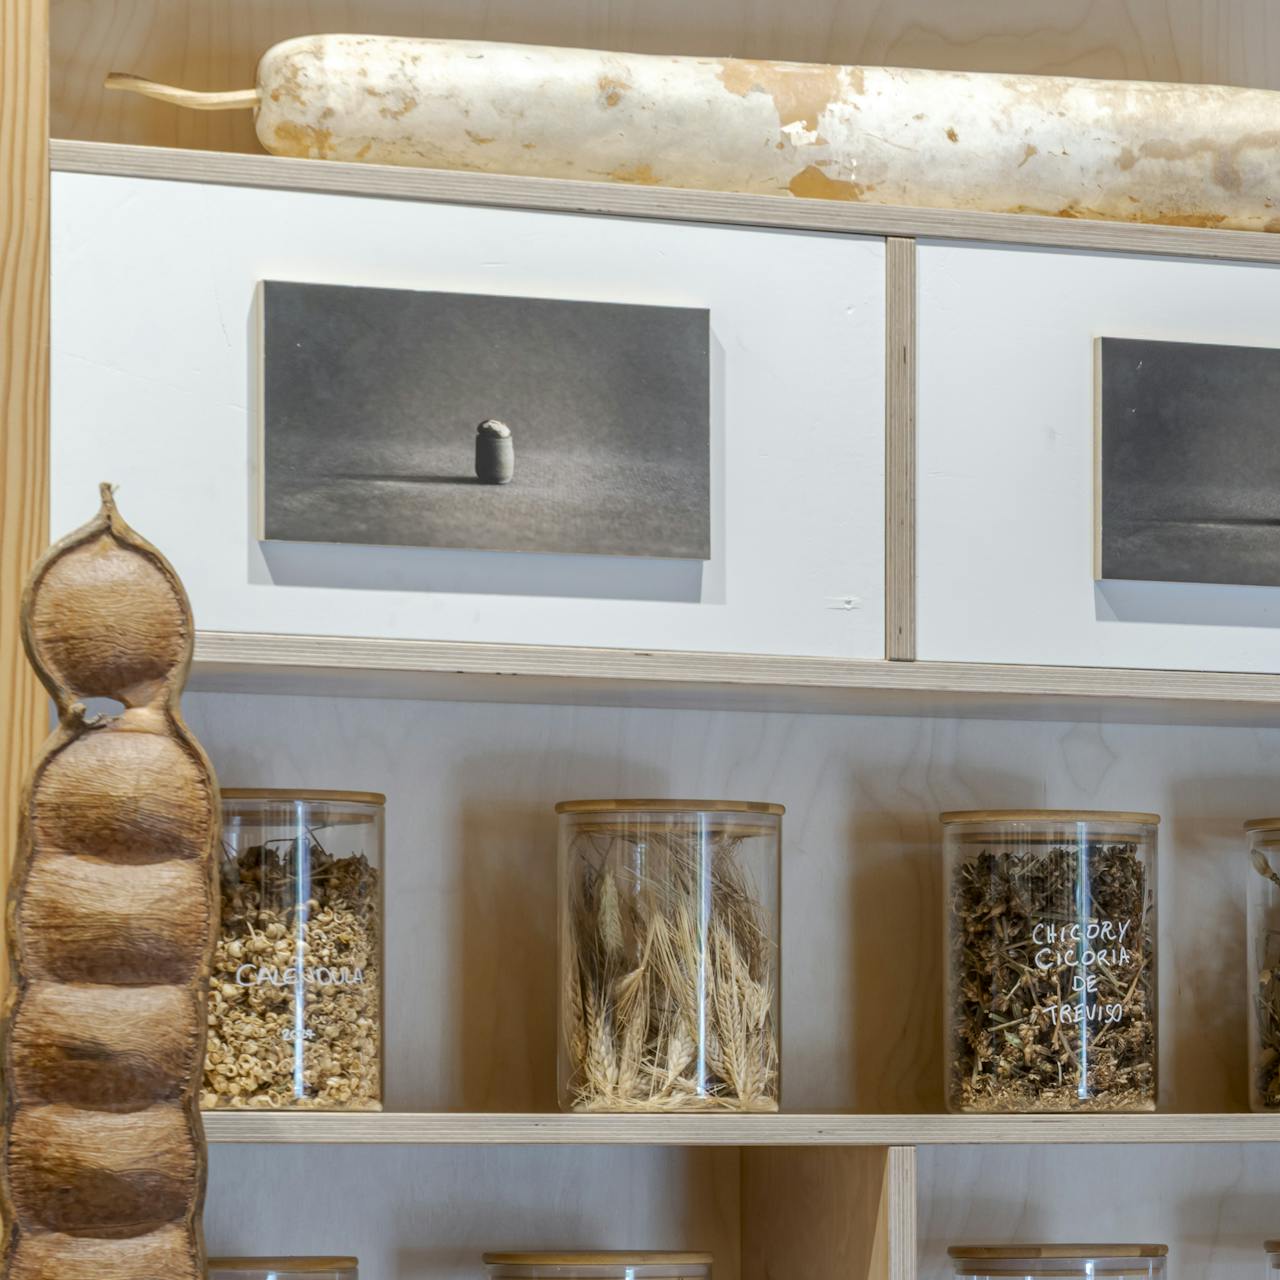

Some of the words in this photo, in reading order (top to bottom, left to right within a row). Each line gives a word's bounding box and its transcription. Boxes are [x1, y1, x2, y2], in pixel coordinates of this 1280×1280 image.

[1032, 919, 1131, 945] CHICORY
[1035, 947, 1130, 969] CICORIA
[236, 963, 364, 986] CALENDULA
[1072, 975, 1098, 992] DE
[1042, 1003, 1122, 1026] TREVISO
